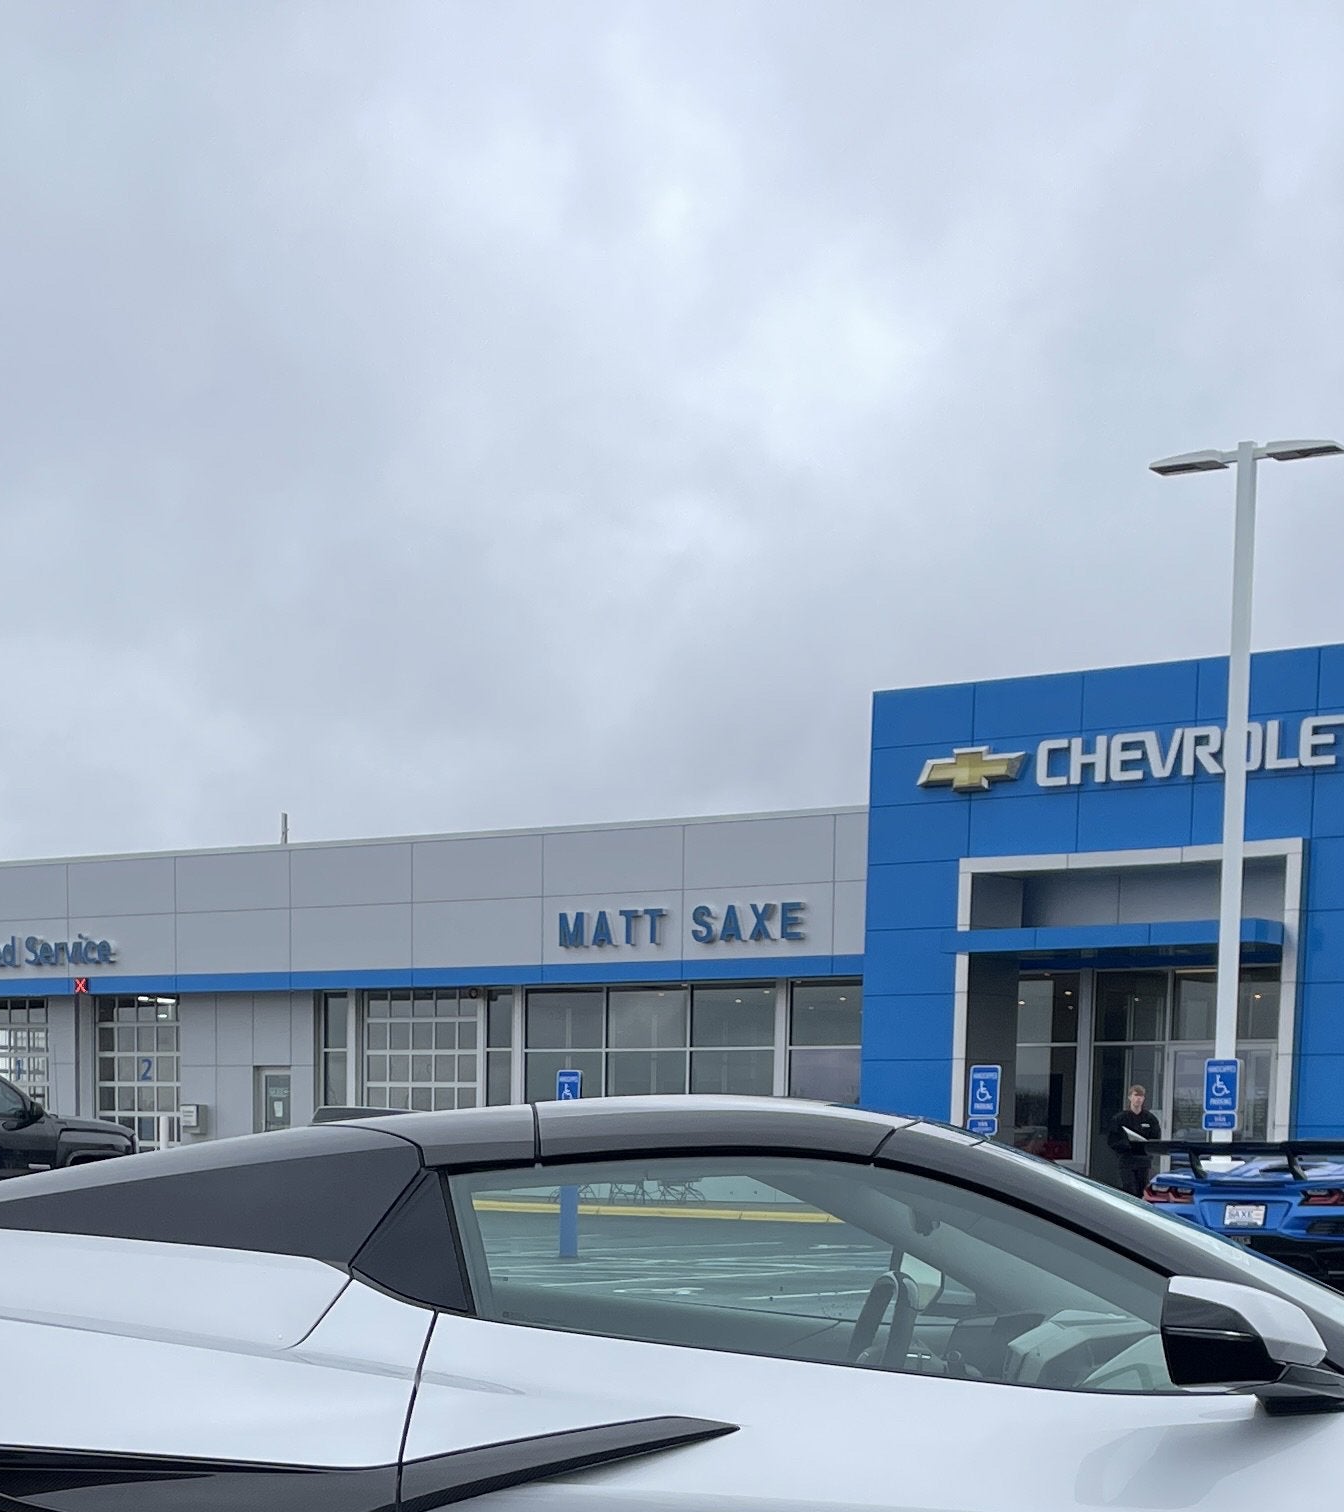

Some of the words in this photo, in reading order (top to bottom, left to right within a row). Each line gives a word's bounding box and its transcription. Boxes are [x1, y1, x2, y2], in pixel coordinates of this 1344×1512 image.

[558, 907, 667, 948] MATT
[691, 902, 807, 945] SAXE
[25, 933, 116, 967] Service
[141, 1058, 153, 1081] 2
